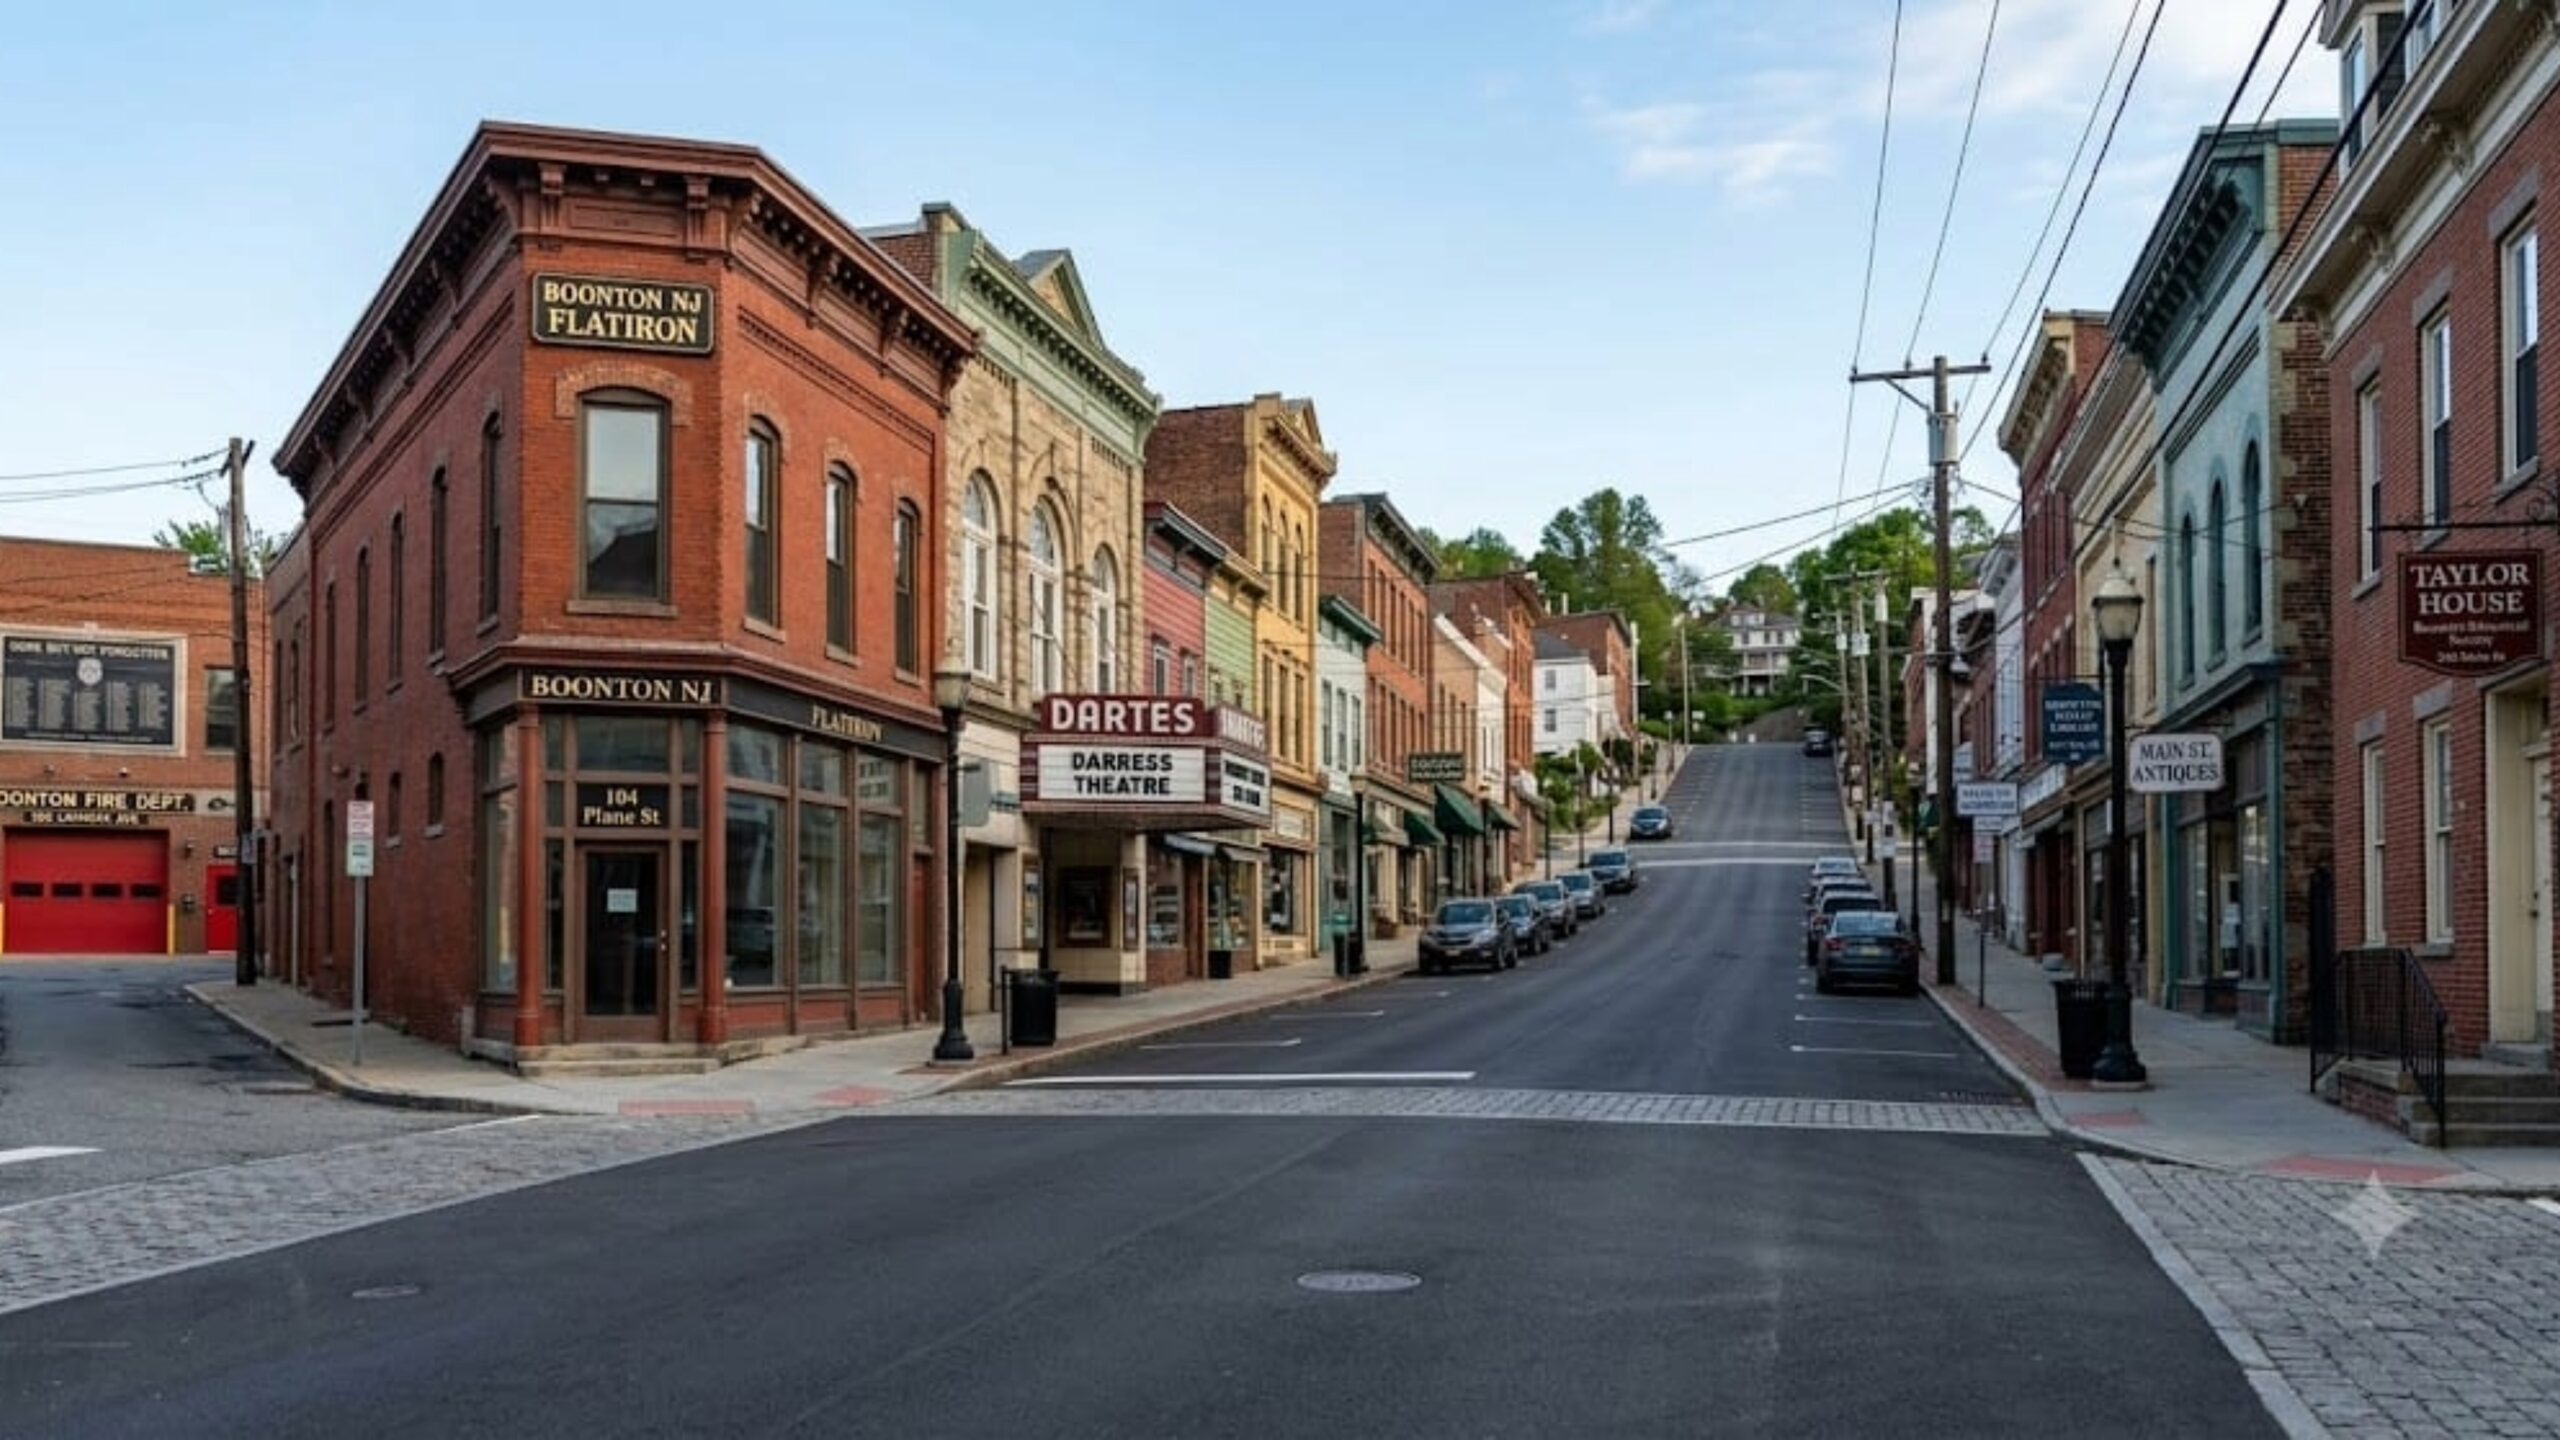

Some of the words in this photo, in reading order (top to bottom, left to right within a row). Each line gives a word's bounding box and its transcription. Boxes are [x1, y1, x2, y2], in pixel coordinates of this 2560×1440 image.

[544, 282, 662, 310] BOONTON
[671, 291, 702, 312] NJ
[548, 308, 698, 343] FLATIRON
[2410, 563, 2530, 588] TAYLOR
[2419, 592, 2524, 614] HOUSE
[532, 675, 672, 700] BOONTON
[1051, 698, 1196, 734] DARTES
[2141, 742, 2183, 760] MAIN
[1072, 752, 1173, 772] DARRESS
[2132, 764, 2218, 784] ANTIQUES
[1073, 776, 1171, 796] THEATRE
[84, 792, 128, 809] FIRE
[135, 794, 189, 811] DEPT.
[607, 788, 638, 806] 104
[583, 806, 636, 825] Plane
[641, 806, 661, 825] St
